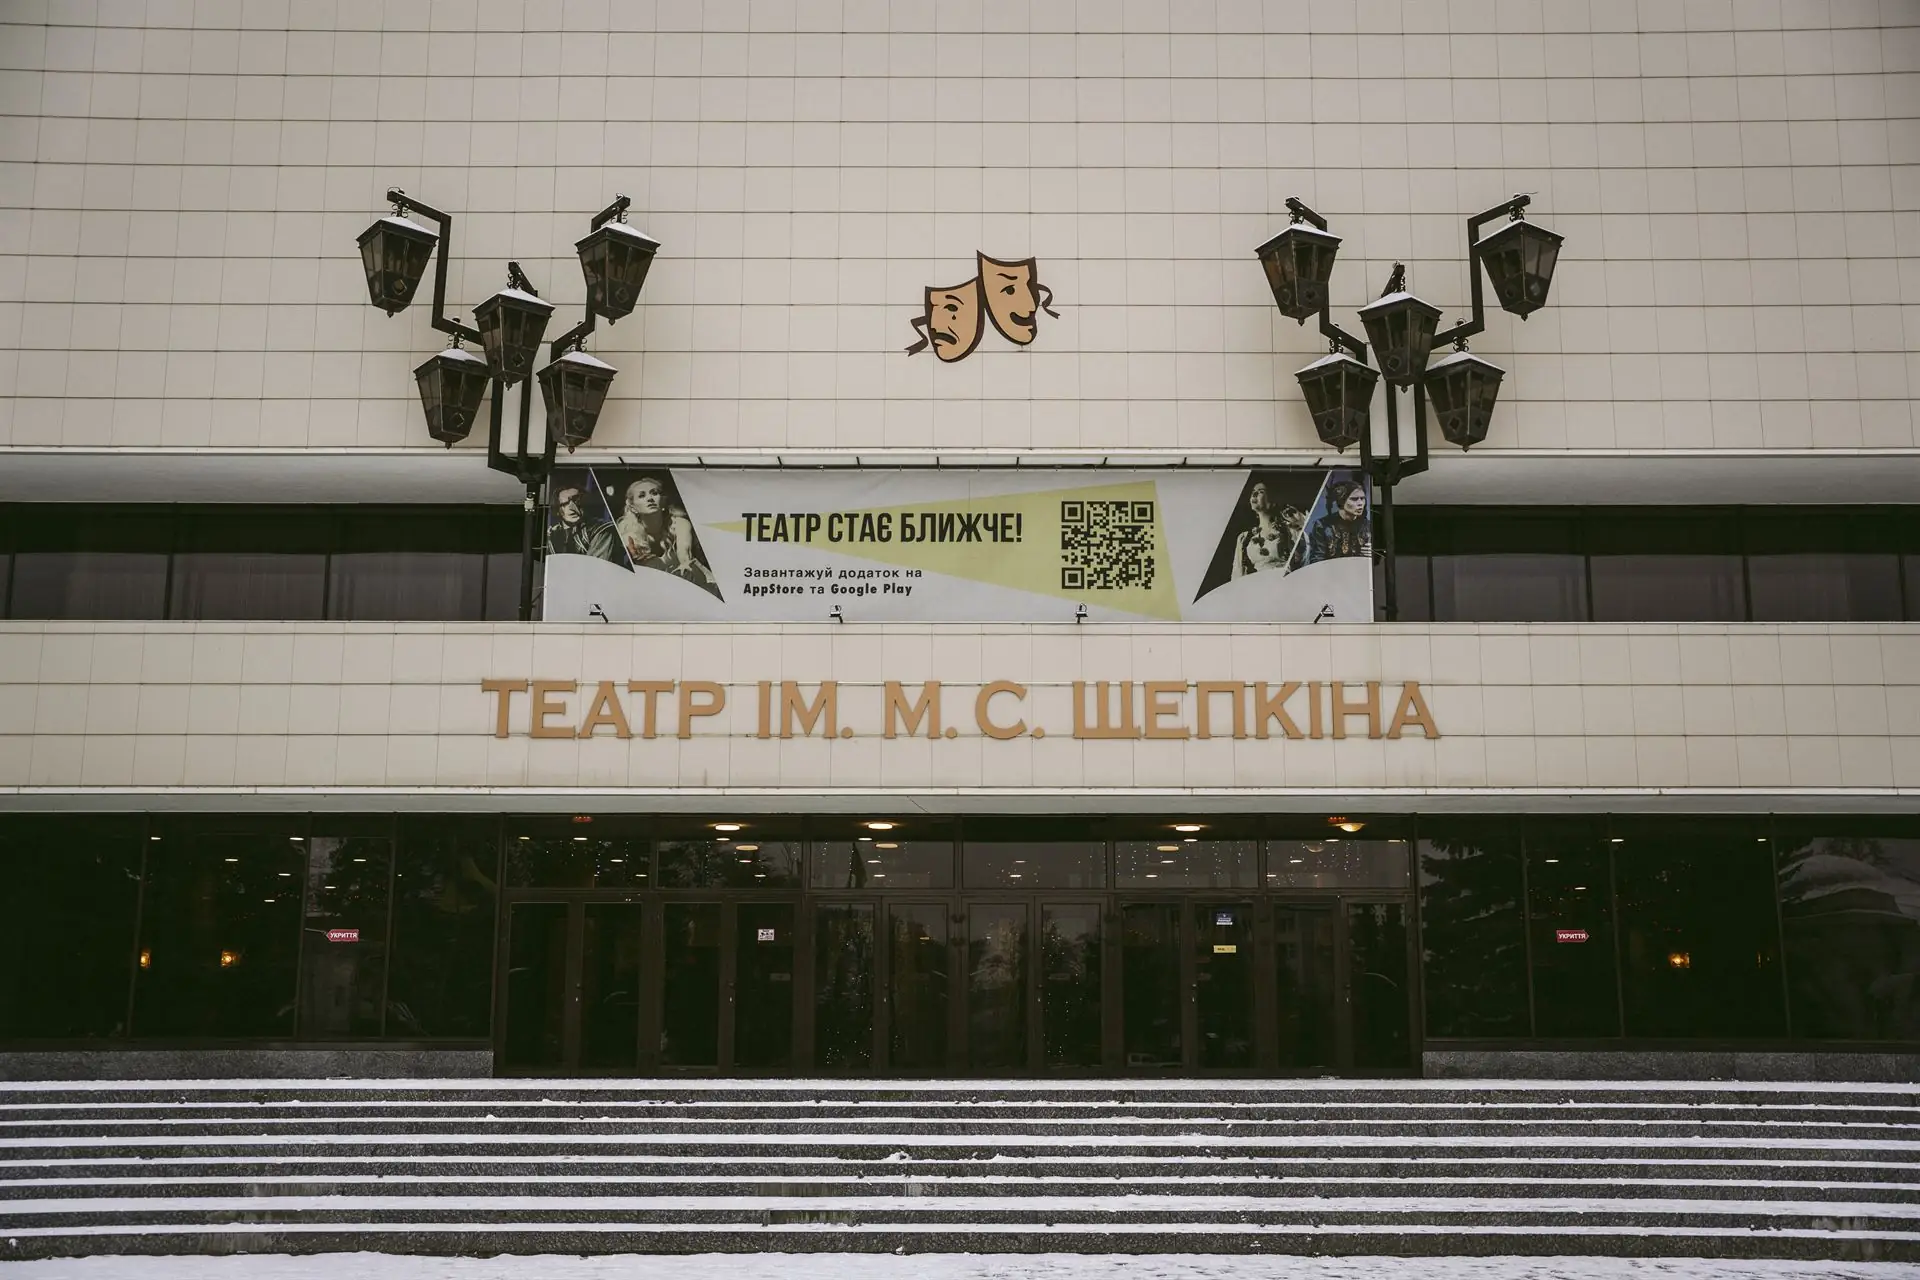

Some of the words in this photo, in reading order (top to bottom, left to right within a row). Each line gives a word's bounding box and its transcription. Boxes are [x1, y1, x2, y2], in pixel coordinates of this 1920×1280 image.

[742, 513, 821, 542] ТЕАТР
[828, 512, 893, 543] СТАЄ
[901, 513, 1022, 543] БЛИЖЧЕ!
[744, 567, 833, 580] Завантажуй
[838, 569, 900, 580] додаток
[906, 570, 922, 578] на
[744, 583, 804, 596] AppStore
[810, 585, 825, 594] та
[831, 583, 877, 597] Google
[883, 583, 912, 596] Play
[482, 678, 726, 739] ТЕАТР
[757, 680, 853, 739] ІМ.
[884, 680, 958, 739] М.
[975, 680, 1045, 739] С.
[1072, 678, 1441, 740] ЩЕПКІНА
